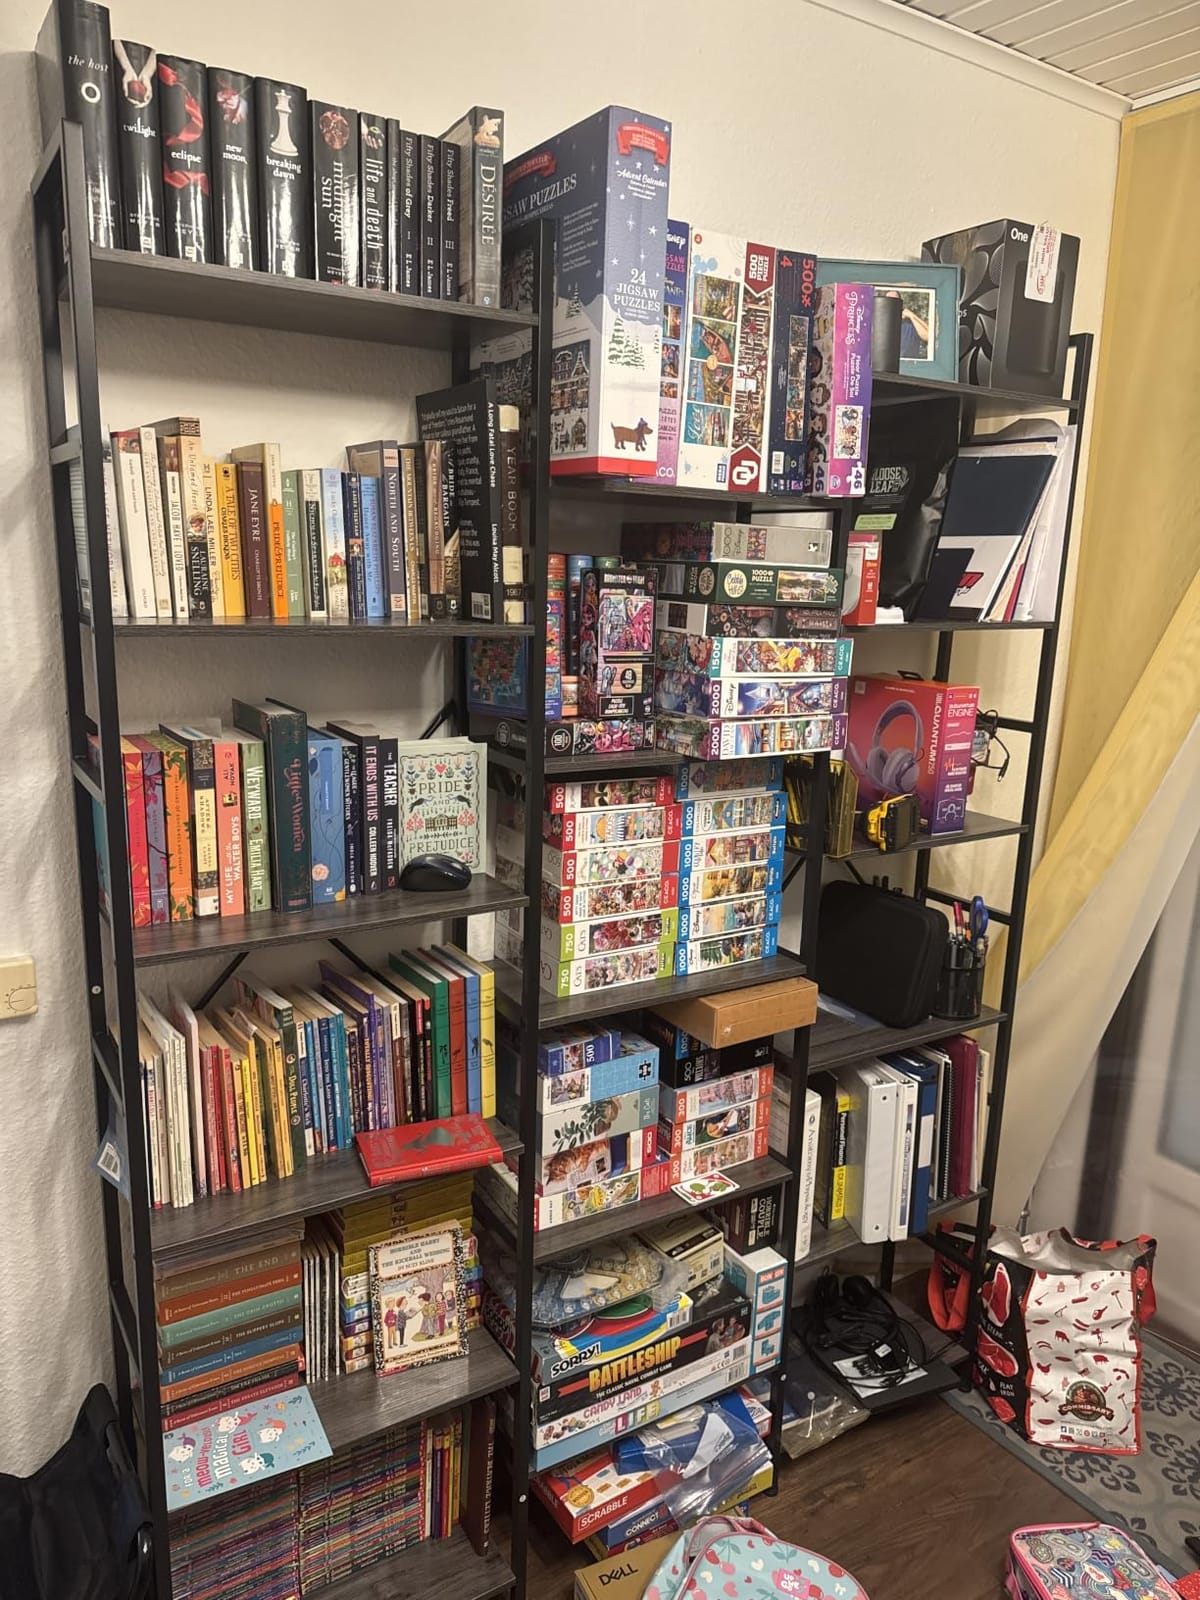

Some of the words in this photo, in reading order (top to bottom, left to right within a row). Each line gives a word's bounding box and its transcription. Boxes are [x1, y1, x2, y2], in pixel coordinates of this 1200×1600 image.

[67, 55, 86, 67] the
[88, 58, 109, 72] host
[123, 118, 157, 138] twilight
[225, 144, 243, 152] new
[405, 137, 413, 156] Fifty
[427, 144, 435, 163] Fifty
[171, 151, 201, 168] eclipse
[222, 152, 247, 164] moon
[266, 155, 302, 174] breaking
[447, 149, 455, 168] Fifty
[272, 168, 296, 181] dawn
[365, 159, 384, 184] life
[405, 157, 413, 187] Shades
[616, 169, 642, 182] Advent
[641, 174, 667, 188] Calendar
[321, 176, 333, 209] sun
[447, 170, 455, 198] Shades
[529, 173, 578, 210] PUZZLES
[366, 187, 377, 204] and
[403, 198, 413, 219] Grey
[426, 194, 435, 223] Darker
[446, 199, 455, 222] Freed
[366, 208, 385, 249] death
[1010, 227, 1029, 242] One
[749, 255, 757, 280] 500
[780, 255, 793, 269] 4
[630, 268, 647, 284] 24
[616, 283, 659, 299] JIGSAW
[613, 294, 661, 312] PUZZLES
[845, 291, 858, 345] PRINCESS
[856, 305, 865, 334] Disney
[849, 353, 857, 374] Puzzle
[849, 375, 856, 384] De
[487, 410, 496, 427] Long
[487, 428, 496, 447] Fatal
[488, 447, 497, 465] Love
[507, 446, 517, 485] YEAR
[447, 468, 456, 498] BRIDE
[488, 466, 497, 488] Chase
[814, 466, 825, 492] 46
[853, 469, 864, 489] 46
[874, 466, 902, 482] LOOSE
[225, 486, 234, 494] A
[387, 472, 399, 508] NORTH
[869, 479, 893, 494] LEAF
[171, 500, 180, 521] JACOB
[204, 486, 214, 514] LINDA
[225, 495, 236, 517] TALE
[248, 488, 260, 516] JANE
[442, 483, 451, 527] BARGAIN
[220, 507, 229, 535] CHARLES
[390, 512, 399, 533] AND
[507, 491, 518, 533] BOOK
[172, 523, 182, 542] HAVE
[206, 514, 216, 535] LAEL
[228, 518, 238, 531] OF
[251, 516, 261, 542] EYRE
[490, 523, 499, 546] Louisa
[207, 536, 218, 567] MILLER
[223, 535, 231, 561] DICKENS
[229, 531, 240, 551] TWO
[722, 527, 733, 558] 1000
[733, 528, 745, 557] Disney
[174, 550, 185, 572] LOVED
[391, 537, 402, 572] SOUTH
[490, 549, 499, 561] May
[191, 545, 201, 597] SNELLING
[200, 550, 209, 591] LAURAINE
[230, 554, 241, 581] CITIES
[492, 562, 500, 584] Alcott
[751, 569, 768, 577] 1000
[751, 575, 774, 583] PUZZLE
[711, 640, 721, 672] 1500
[711, 684, 722, 716] 2000
[724, 683, 737, 715] Disney
[947, 708, 974, 718] ENGINE
[365, 746, 378, 755] IT
[710, 726, 721, 757] 2000
[284, 757, 303, 798] Little
[365, 757, 379, 782] ENDS
[680, 767, 689, 791] 1000
[246, 766, 264, 819] WEYWARD
[367, 783, 379, 808] WITH
[384, 762, 399, 807] TEACHER
[419, 780, 463, 795] PRIDE
[555, 787, 565, 809] 500
[230, 815, 240, 837] BOYS
[290, 798, 306, 852] Women
[367, 809, 379, 822] US
[685, 806, 694, 831] 1000
[368, 826, 378, 853] COLLEEN
[386, 818, 394, 839] FREIDA
[565, 821, 574, 843] 500
[250, 839, 264, 869] EMILIA
[348, 843, 356, 860] INDIA
[386, 840, 395, 870] McFADDEN
[408, 837, 474, 854] PREJUDICE
[683, 843, 692, 868] 1000
[233, 839, 243, 882] WALTER
[369, 853, 379, 877] HOOVER
[566, 859, 575, 881] 500
[224, 866, 235, 886] LIFE
[251, 870, 265, 891] HART
[349, 863, 357, 884] HOLTON
[226, 887, 235, 904] MY
[681, 877, 690, 902] 1000
[562, 895, 572, 918] 500
[681, 913, 690, 938] 1000
[692, 910, 703, 934] Disney
[565, 933, 574, 954] 750
[679, 947, 688, 972] 1000
[560, 969, 570, 990] 750
[586, 1044, 595, 1063] 500
[684, 1061, 693, 1082] 500
[288, 1076, 298, 1092] DOLL
[290, 1093, 300, 1115] PEOPLE
[677, 1097, 687, 1118] 300
[837, 1112, 848, 1139] Personal
[673, 1129, 682, 1148] 300
[835, 1140, 846, 1166] Finance
[671, 1160, 681, 1180] 300
[234, 1264, 255, 1275] THE
[258, 1256, 279, 1268] END
[551, 1345, 600, 1379] SORRY!
[589, 1336, 682, 1393] BATTLESHIP
[596, 1390, 605, 1399] THE
[604, 1384, 624, 1398] CLASSIC
[624, 1377, 640, 1390] NAVAL
[639, 1370, 660, 1386] COMBAT
[659, 1362, 673, 1375] GAME
[583, 1396, 617, 1419] CANDY
[617, 1386, 642, 1408] LAND
[1060, 1401, 1113, 1417] COMMISSARY
[614, 1400, 662, 1435] LIFE
[580, 1497, 628, 1528] SCRABBLE
[625, 1512, 660, 1537] CONNECT
[598, 1563, 639, 1586] DELL
